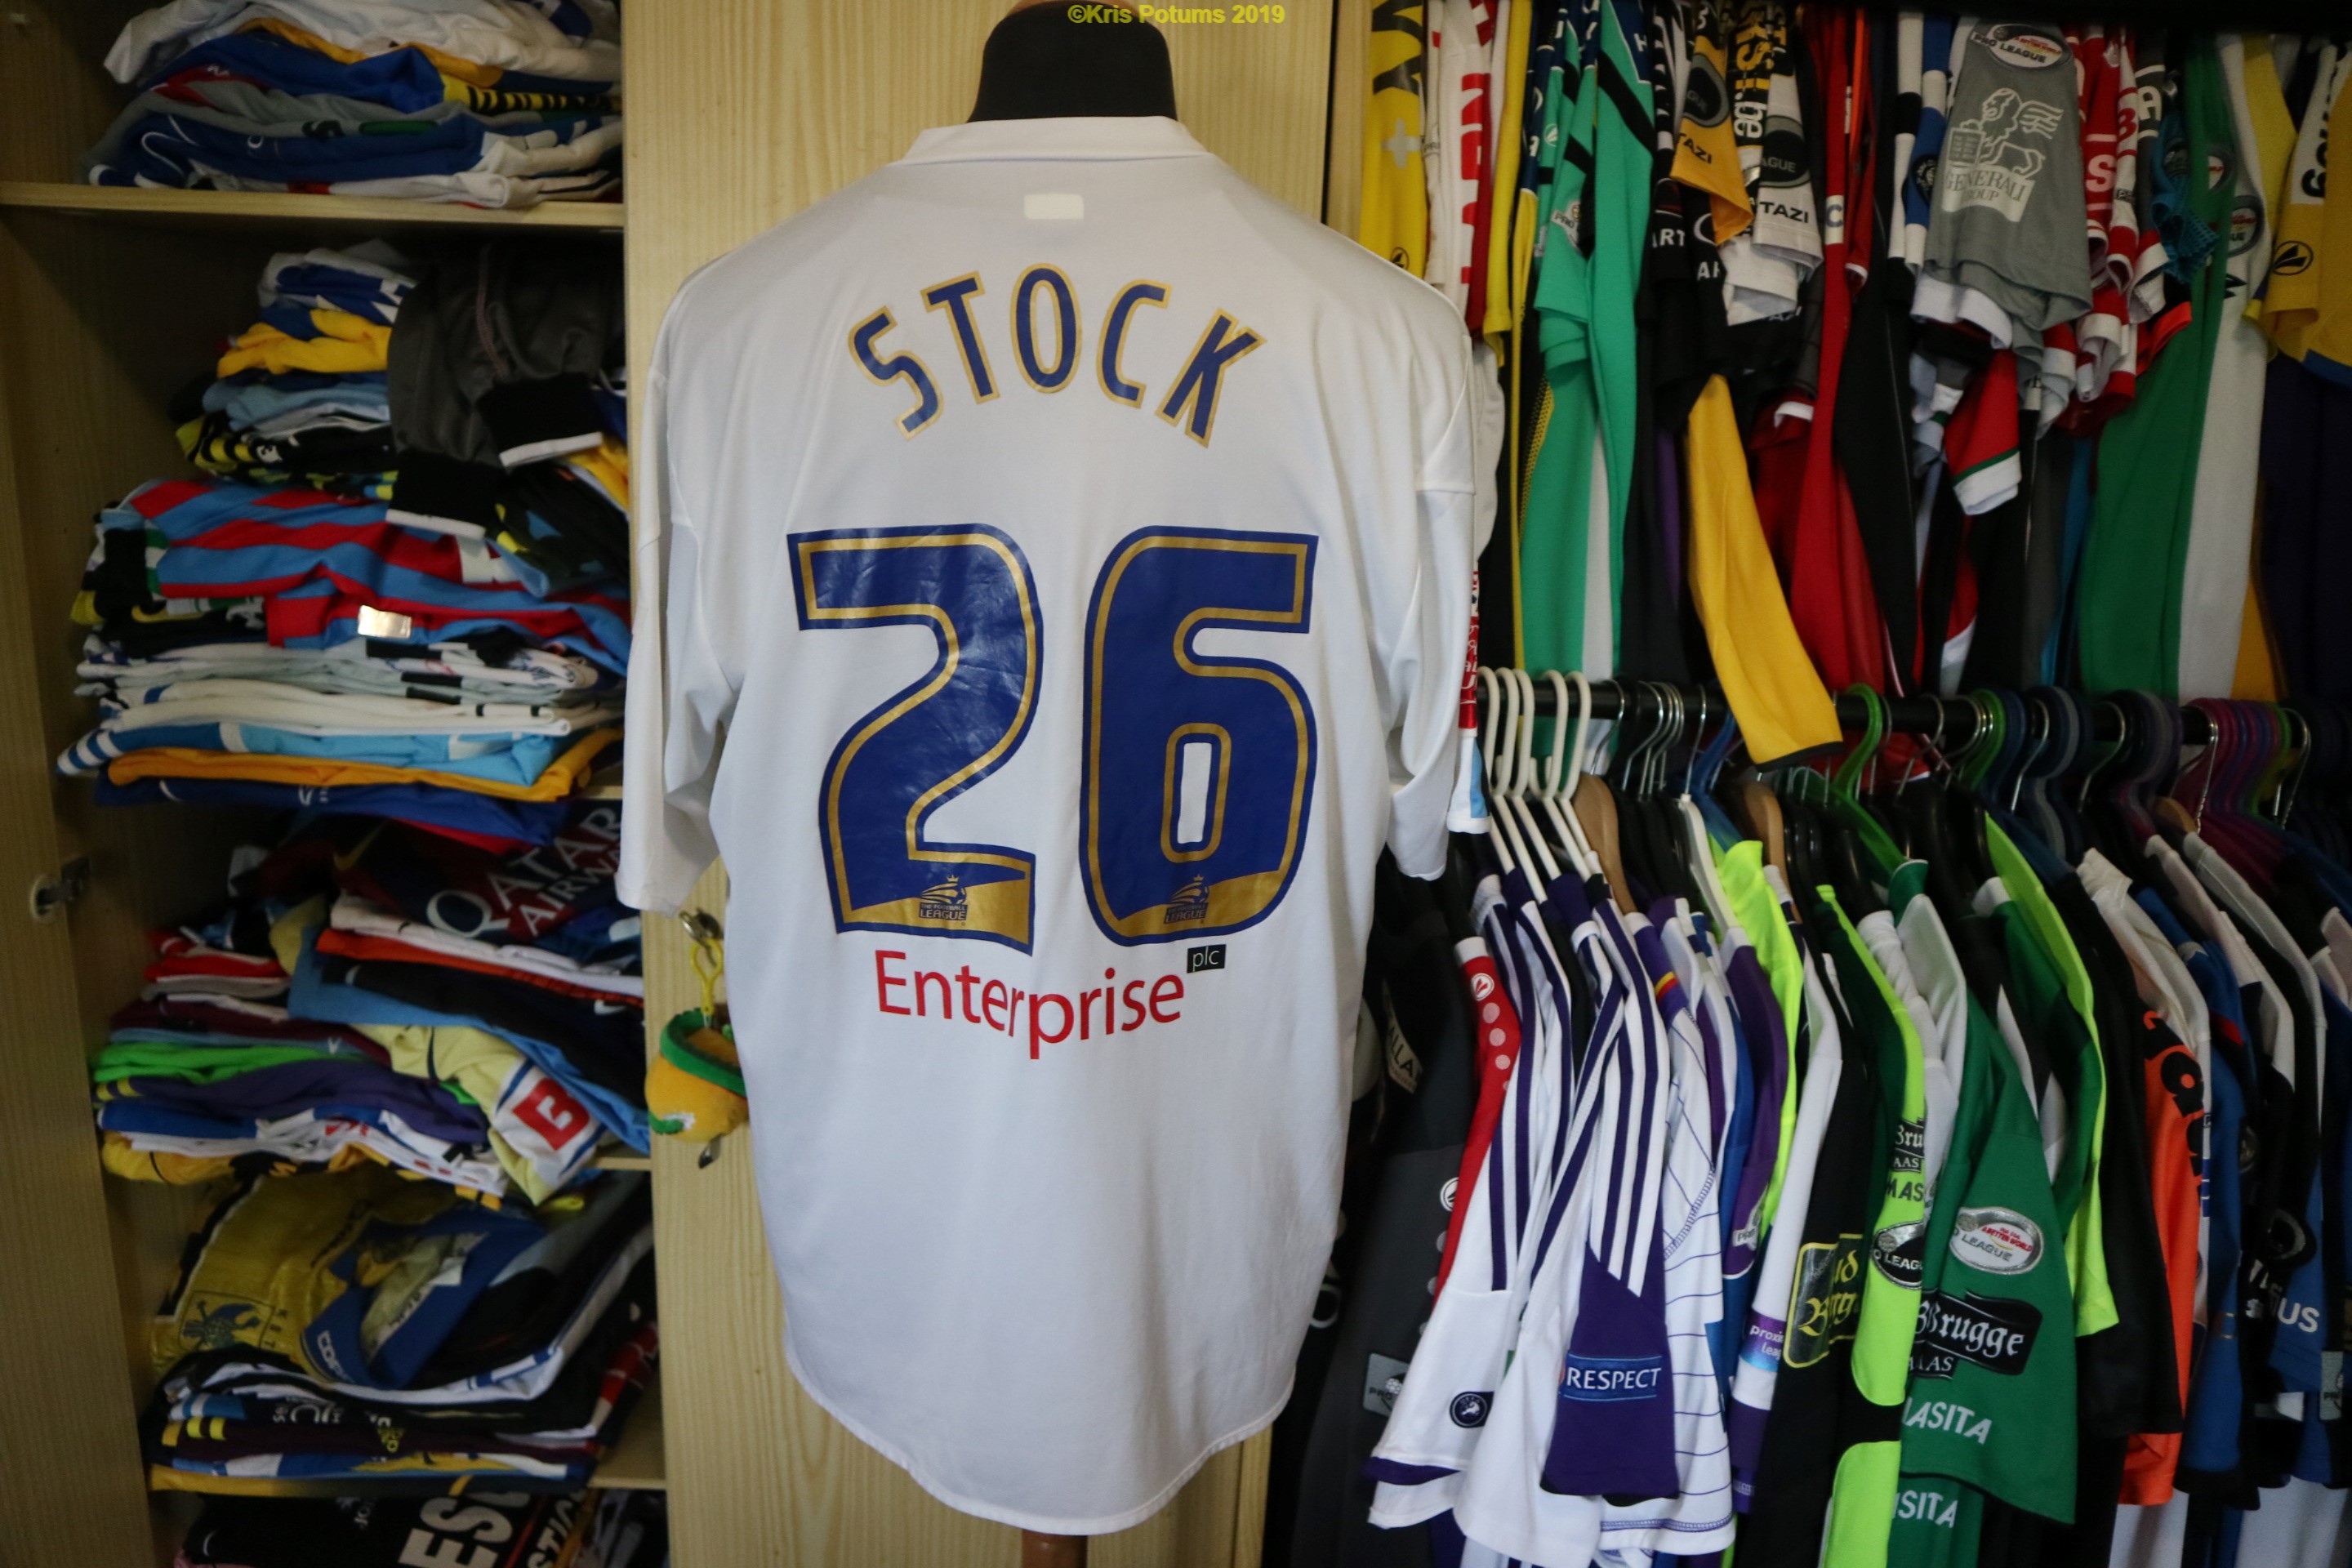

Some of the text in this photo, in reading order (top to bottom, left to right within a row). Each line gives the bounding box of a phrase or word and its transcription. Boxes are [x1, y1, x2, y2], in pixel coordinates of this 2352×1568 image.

[1975, 33, 2047, 64] PRO LEAGUE
[1760, 201, 1809, 223] TAZI
[847, 262, 1267, 449] STOCK
[787, 523, 1319, 956] 26
[426, 806, 621, 939] QATAR
[920, 908, 966, 920] LEAGUE
[875, 945, 1220, 1059] Enterprise plc
[1962, 1234, 2012, 1263] LEAGUE
[1566, 1366, 1663, 1390] RESPECT
